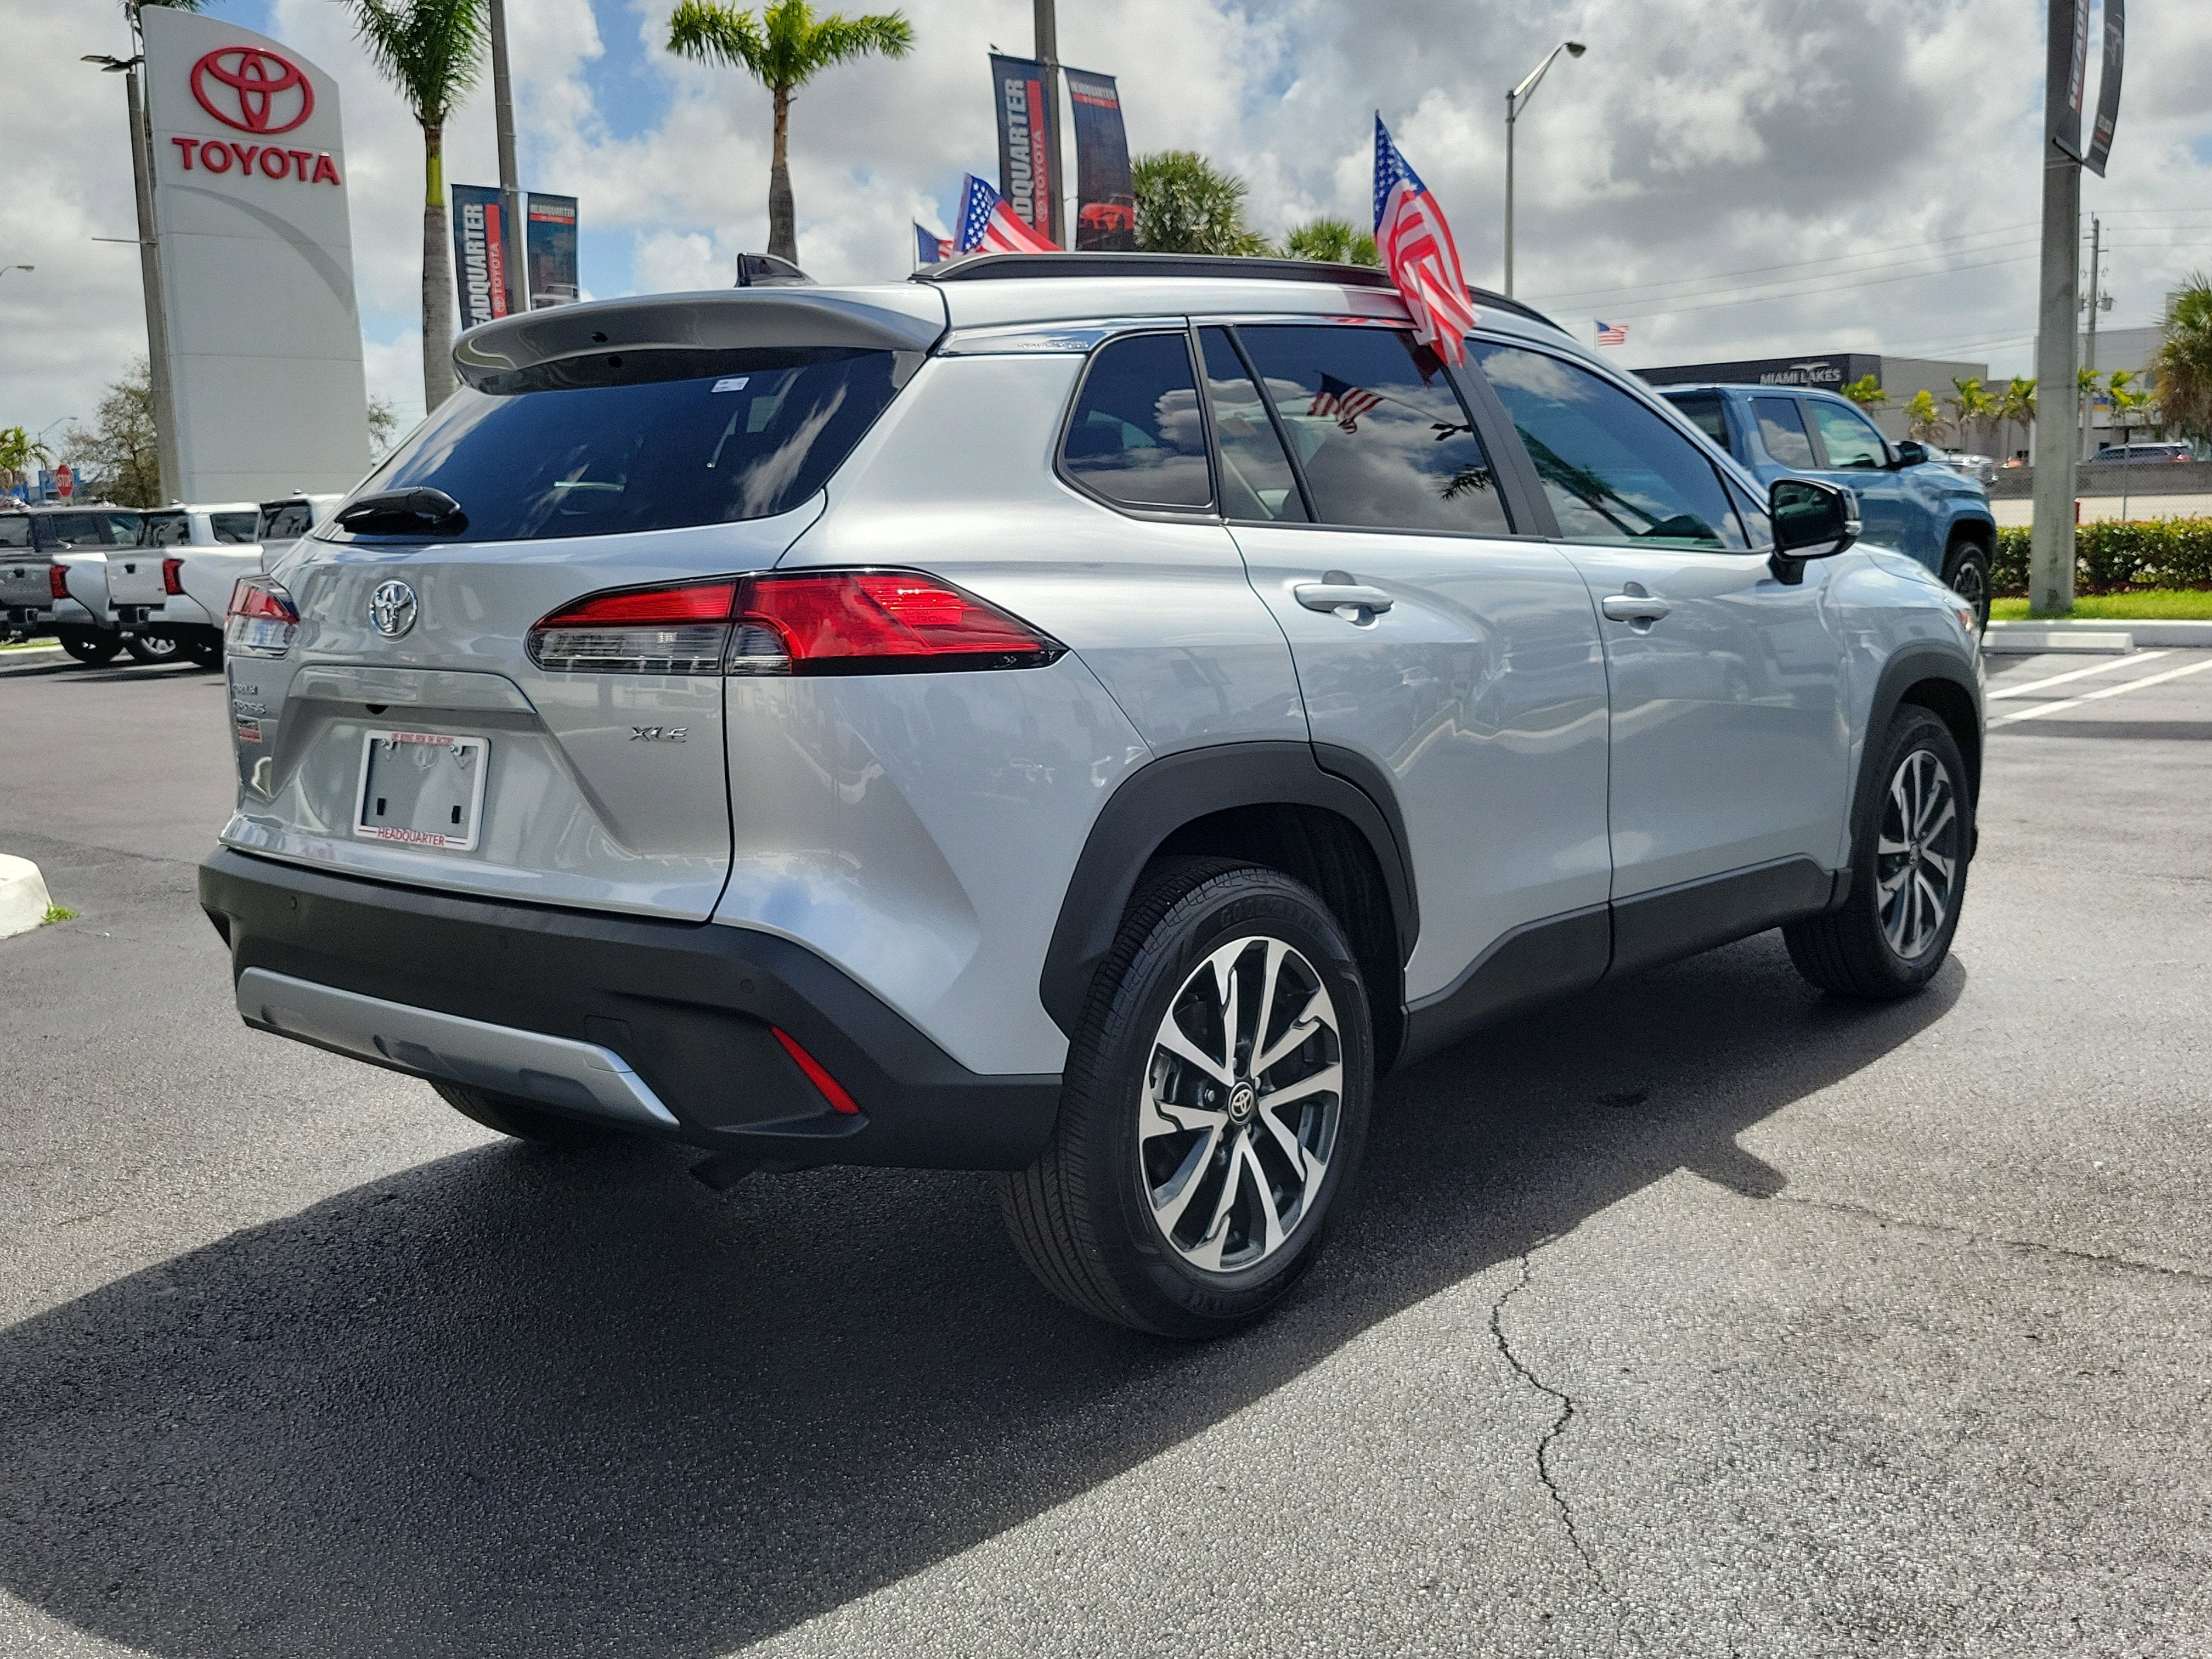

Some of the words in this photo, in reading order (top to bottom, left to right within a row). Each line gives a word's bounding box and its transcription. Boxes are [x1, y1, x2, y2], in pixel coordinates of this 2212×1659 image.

[171, 137, 342, 186] TOYOTA
[1004, 78, 1034, 228] DQUARTER
[1032, 129, 1047, 196] TOYOTA
[464, 203, 492, 328] ADQUARTER
[488, 241, 503, 294] TOYOTA
[1760, 371, 1798, 385] MIAMI
[1800, 368, 1842, 383] LAKES
[57, 473, 72, 488] STOP
[629, 725, 689, 743] XLE
[377, 827, 445, 846] HEADQUARTER
